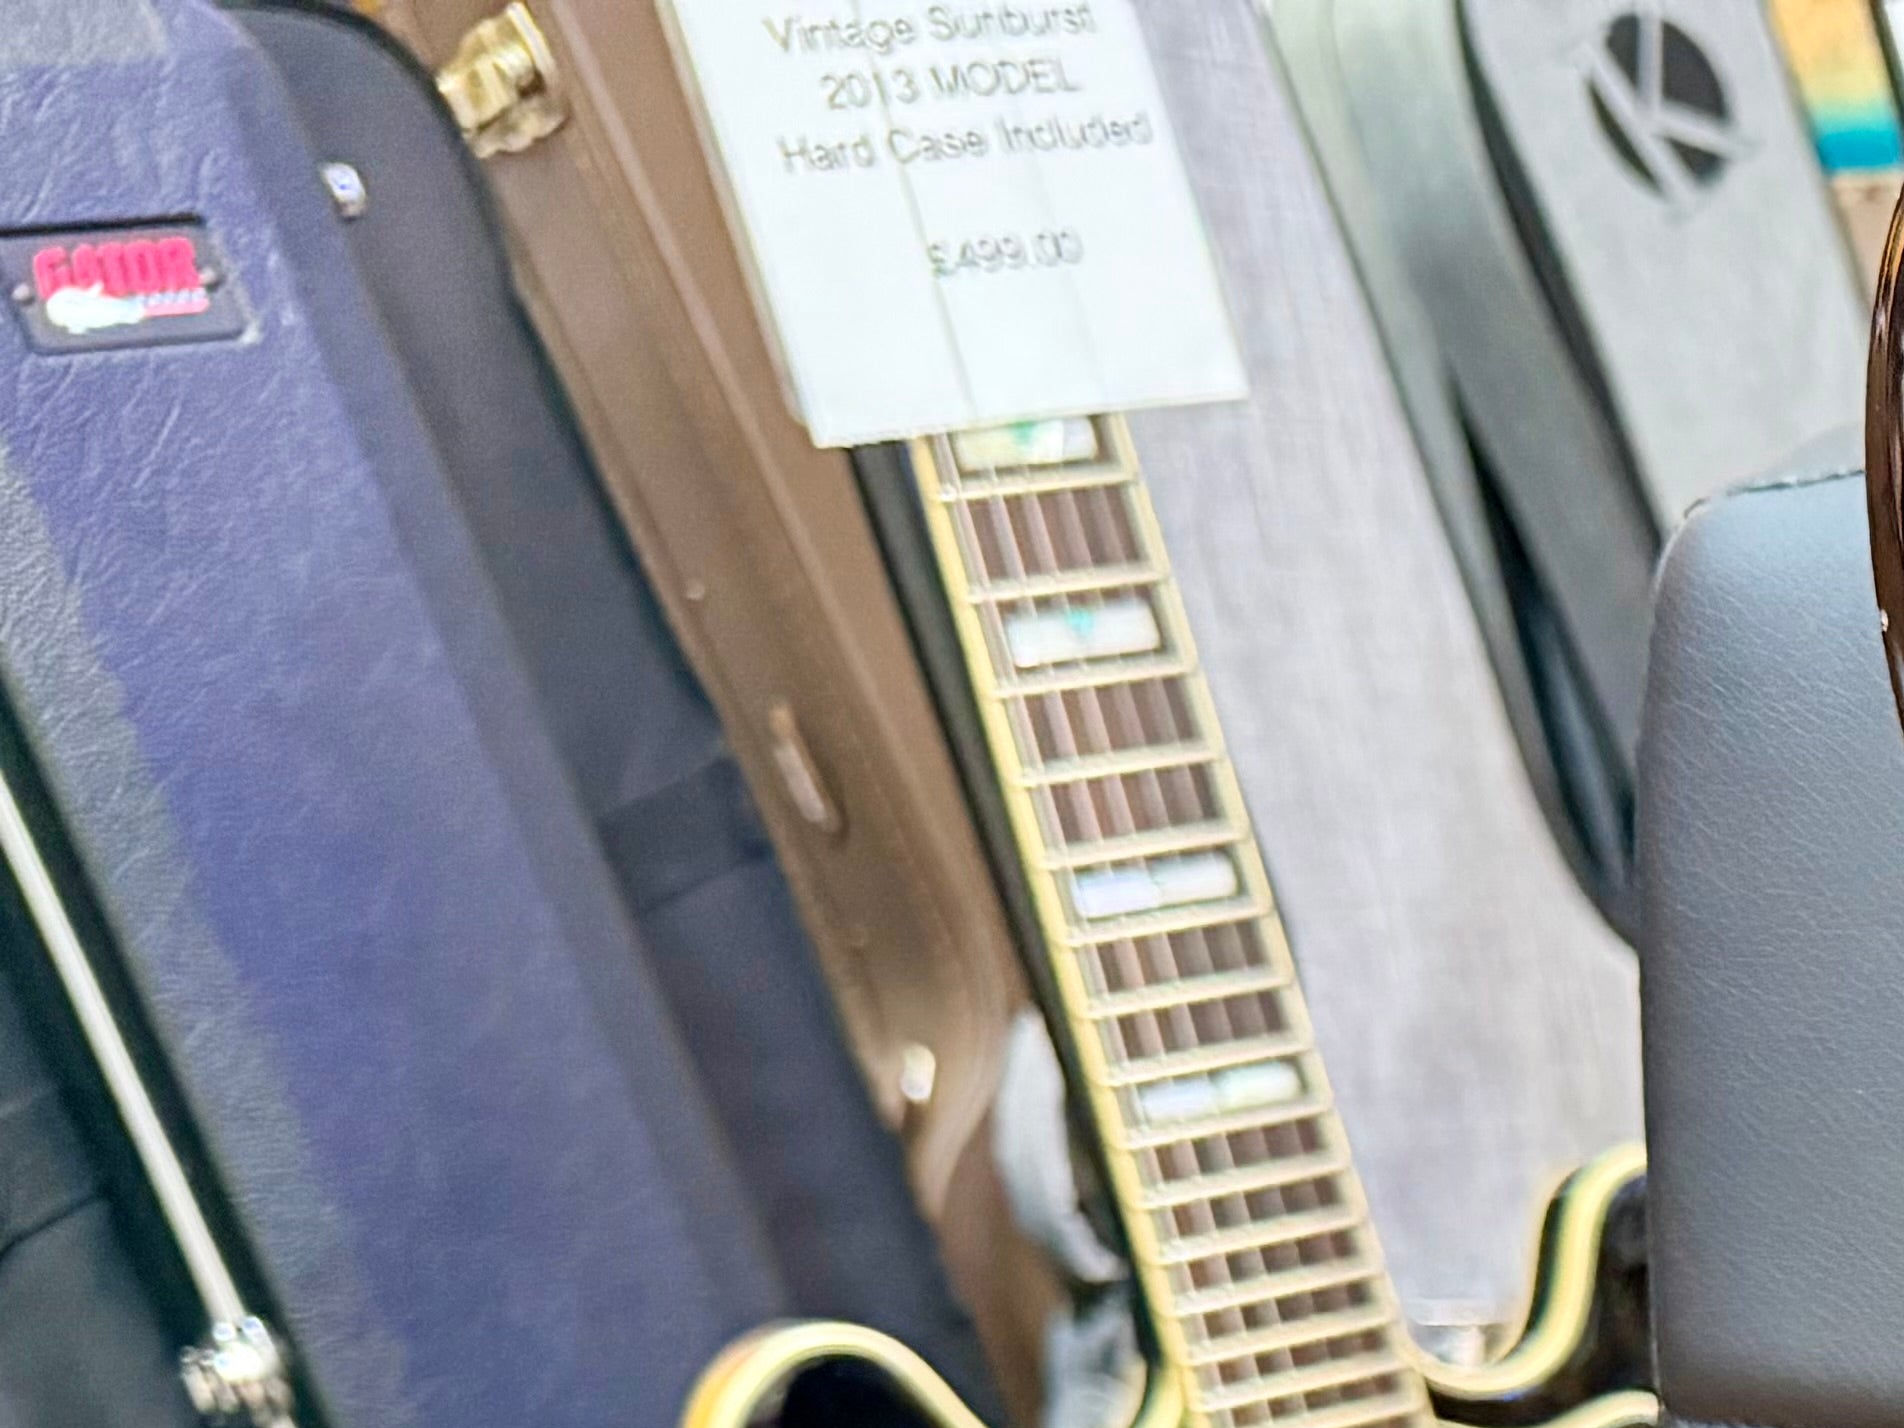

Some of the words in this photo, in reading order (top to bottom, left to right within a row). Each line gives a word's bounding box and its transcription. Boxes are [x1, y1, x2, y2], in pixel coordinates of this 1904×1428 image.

[762, 14, 917, 56] Vintage
[927, 3, 1099, 42] Sunburst
[820, 64, 922, 110] 2013
[930, 55, 1086, 100] MODEL
[776, 132, 878, 173] Hard
[886, 123, 991, 165] Case
[994, 109, 1155, 151] Included
